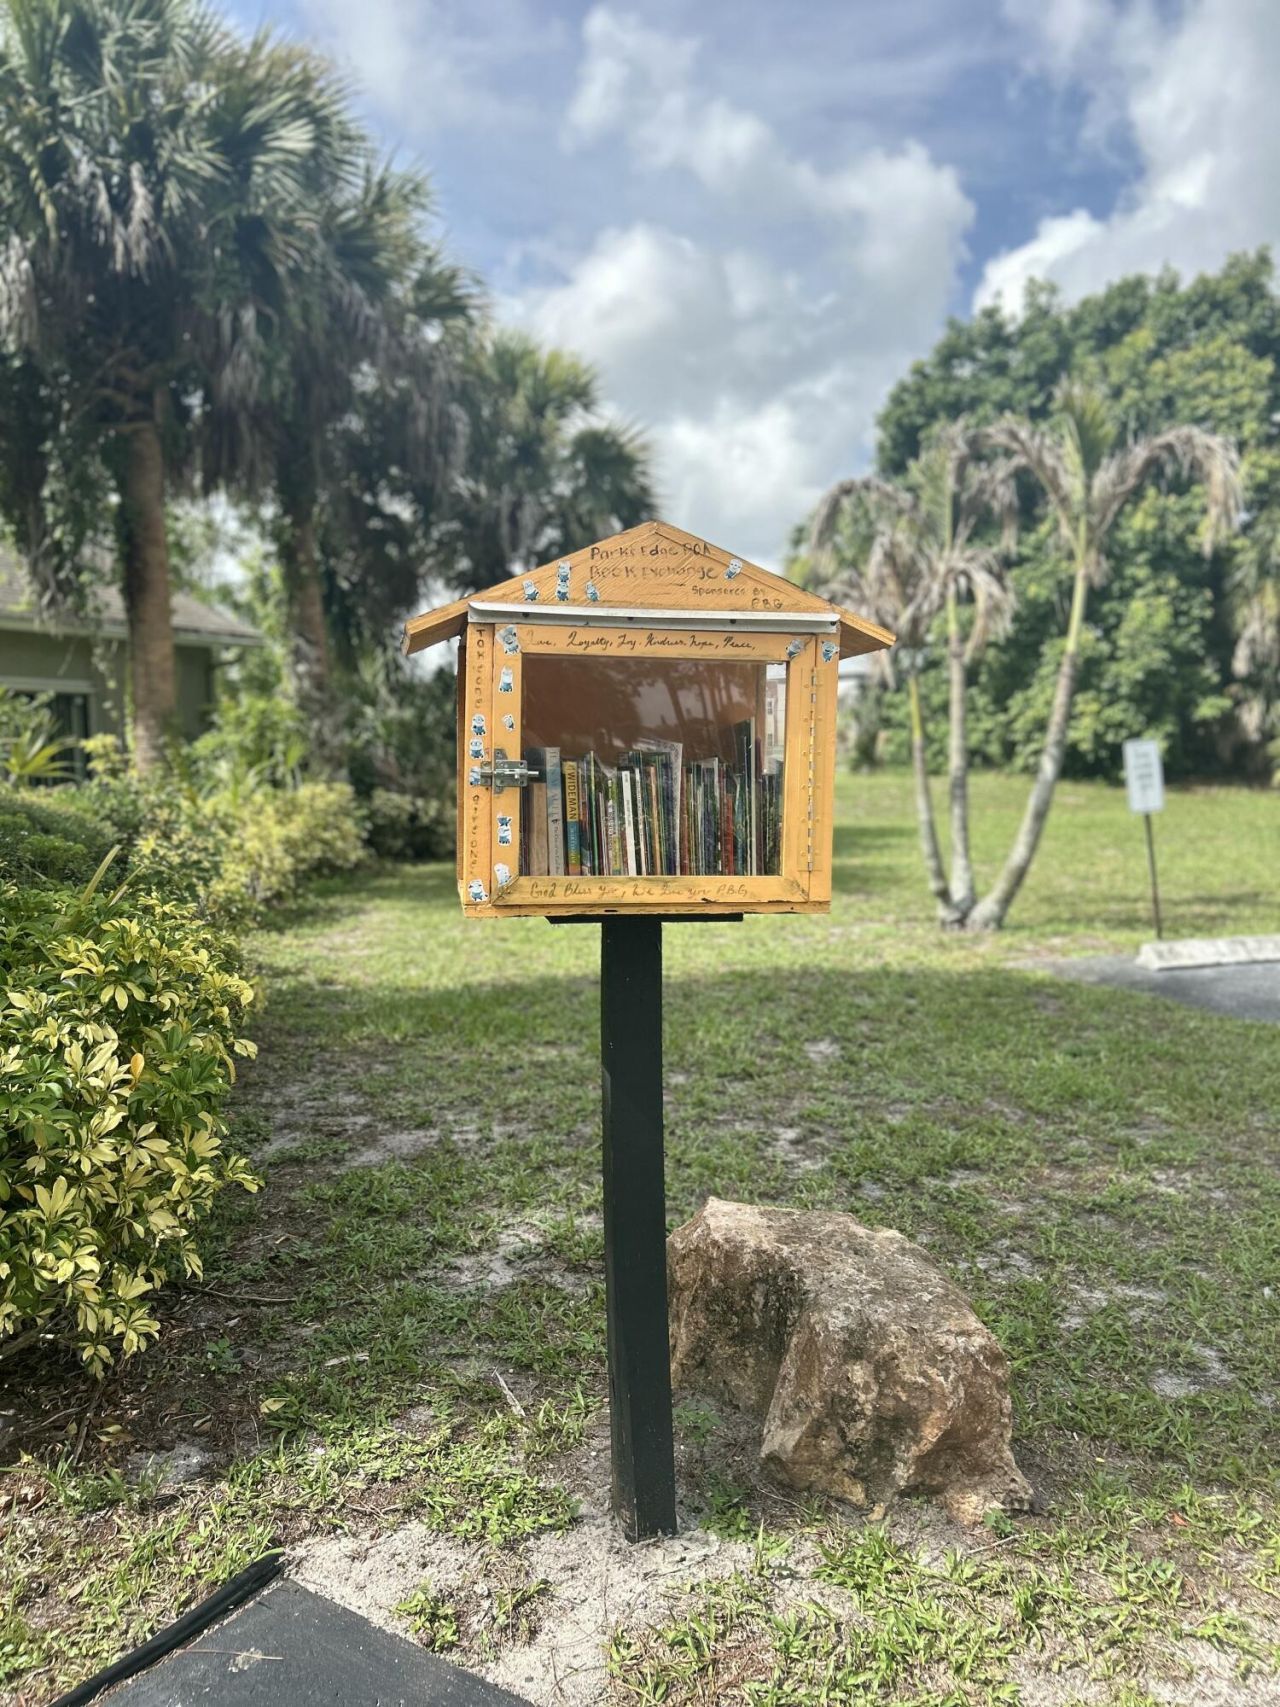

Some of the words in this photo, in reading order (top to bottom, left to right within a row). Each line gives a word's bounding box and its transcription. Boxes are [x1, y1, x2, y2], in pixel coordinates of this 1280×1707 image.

[566, 630, 613, 651] Loyalty,
[568, 771, 577, 820] WIDEMAN
[530, 882, 556, 898] God
